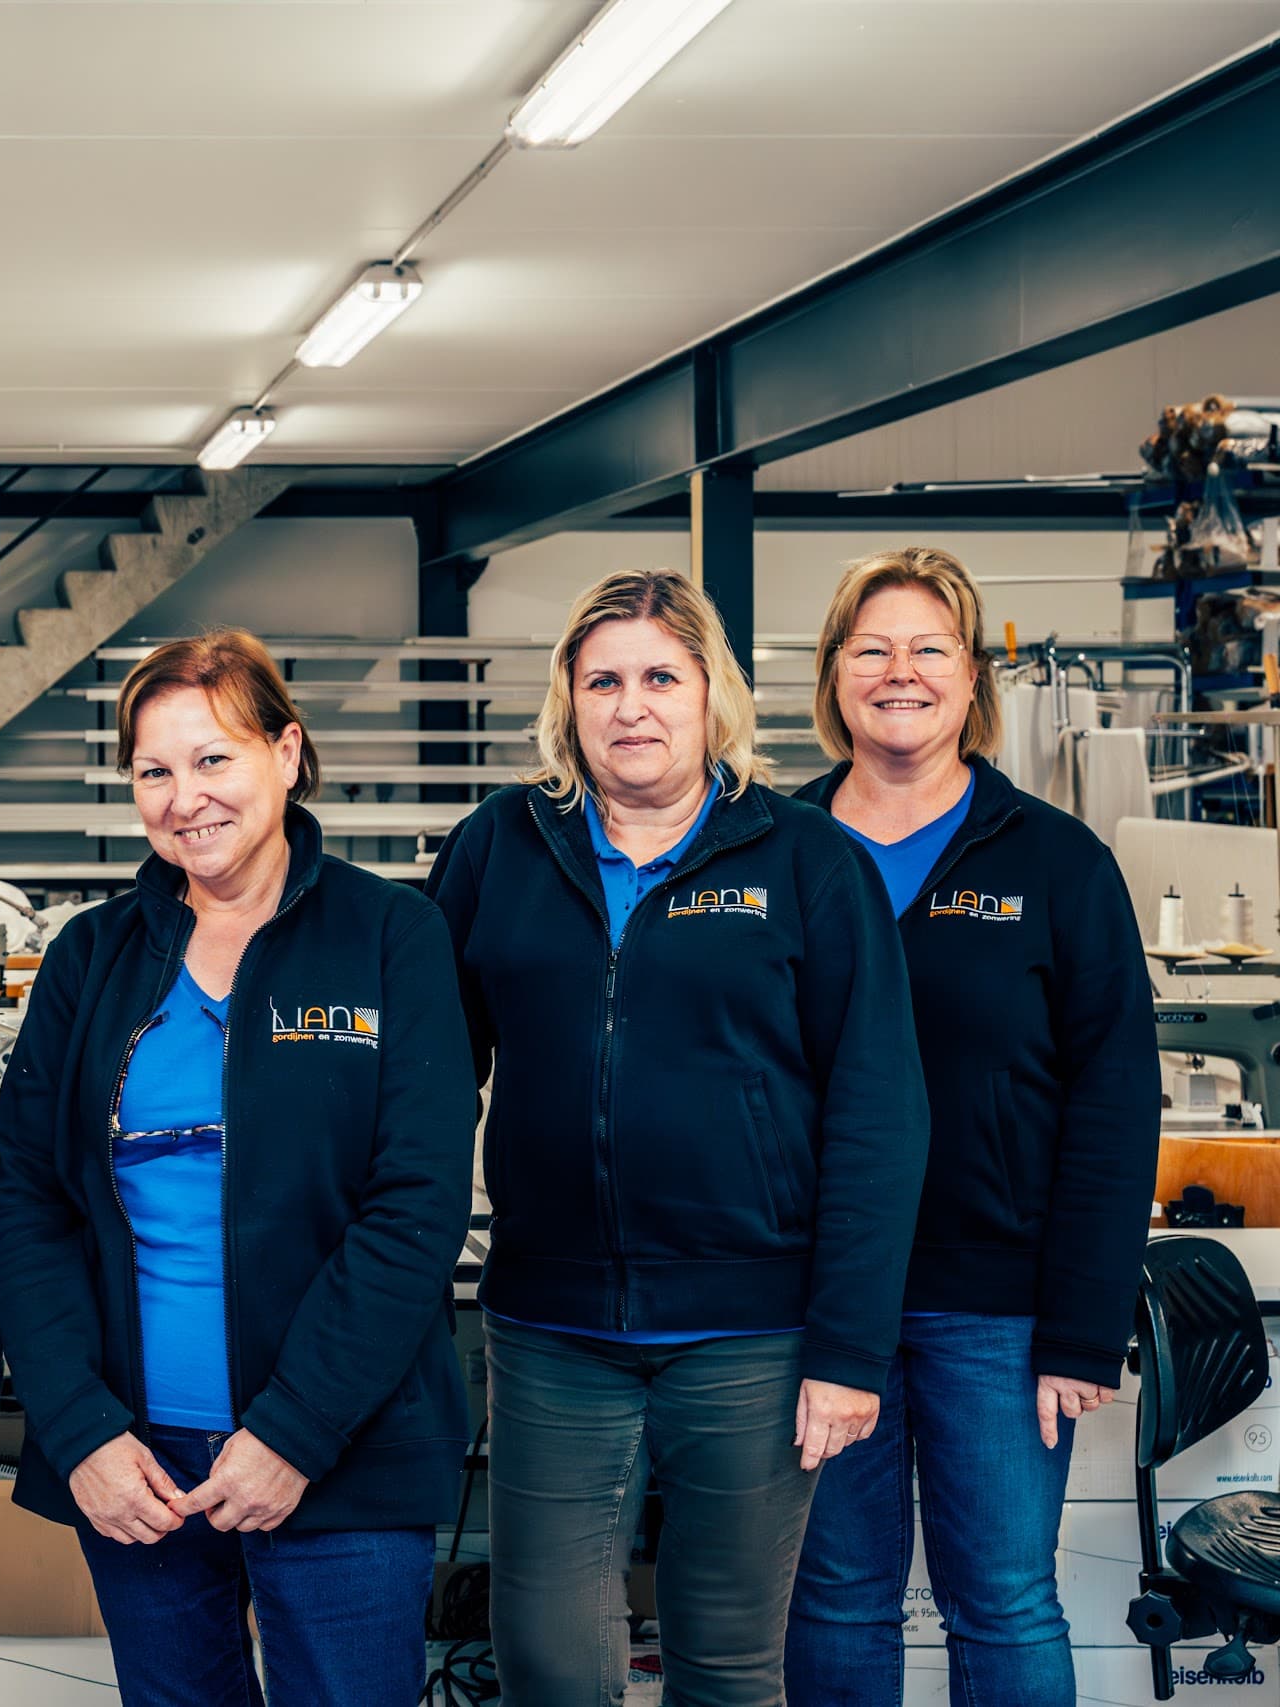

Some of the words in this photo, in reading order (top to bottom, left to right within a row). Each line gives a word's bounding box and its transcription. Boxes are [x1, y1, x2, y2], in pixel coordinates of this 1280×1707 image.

[668, 908, 707, 919] gordijnen
[724, 907, 767, 920] zonwering
[982, 914, 1021, 922] zonwering
[1158, 1012, 1194, 1023] brother
[272, 1032, 315, 1043] gordijnen
[334, 1034, 379, 1049] zonwering
[1248, 1431, 1268, 1446] 95
